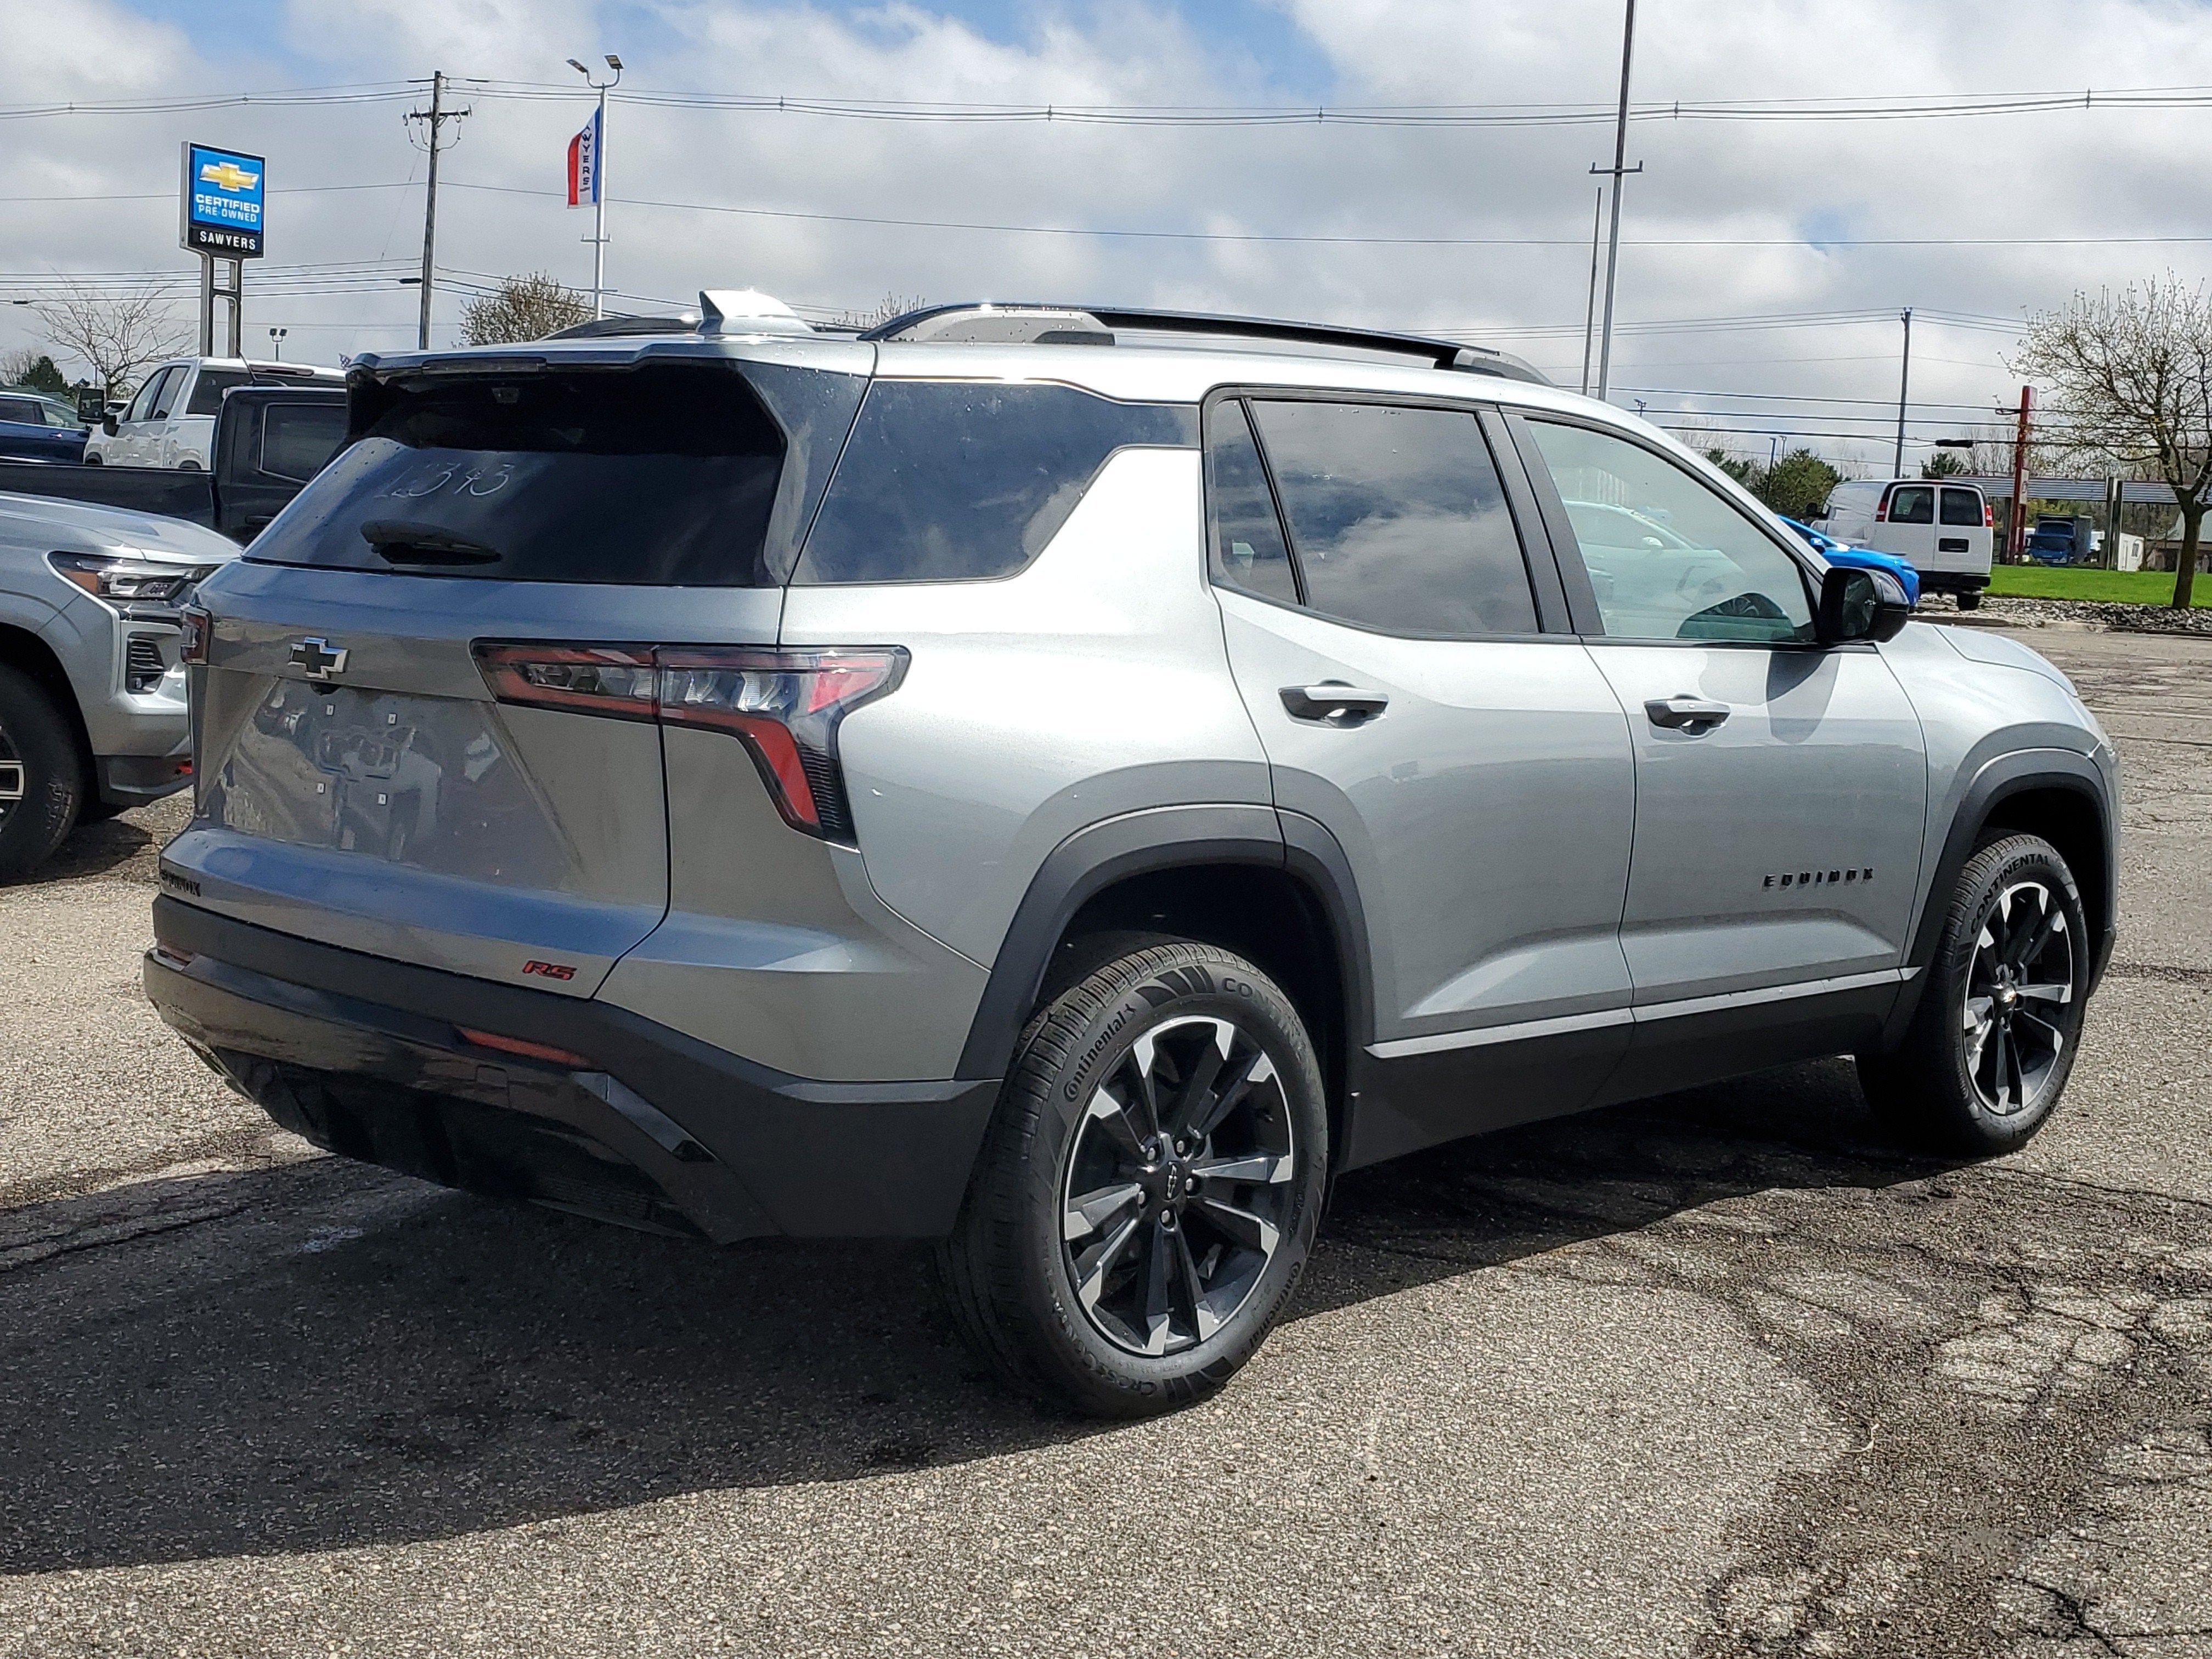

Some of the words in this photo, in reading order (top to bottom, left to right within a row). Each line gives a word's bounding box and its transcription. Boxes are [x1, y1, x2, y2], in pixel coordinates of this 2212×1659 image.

[195, 194, 259, 213] CERTIFIED
[198, 205, 218, 216] PRE
[221, 208, 257, 222] OWNED
[200, 230, 256, 250] SAWYERS
[1763, 868, 1874, 887] EQUINOX
[1970, 854, 2051, 935] CONTINENTAL
[522, 960, 578, 980] RS
[1063, 1010, 1127, 1103] Continental
